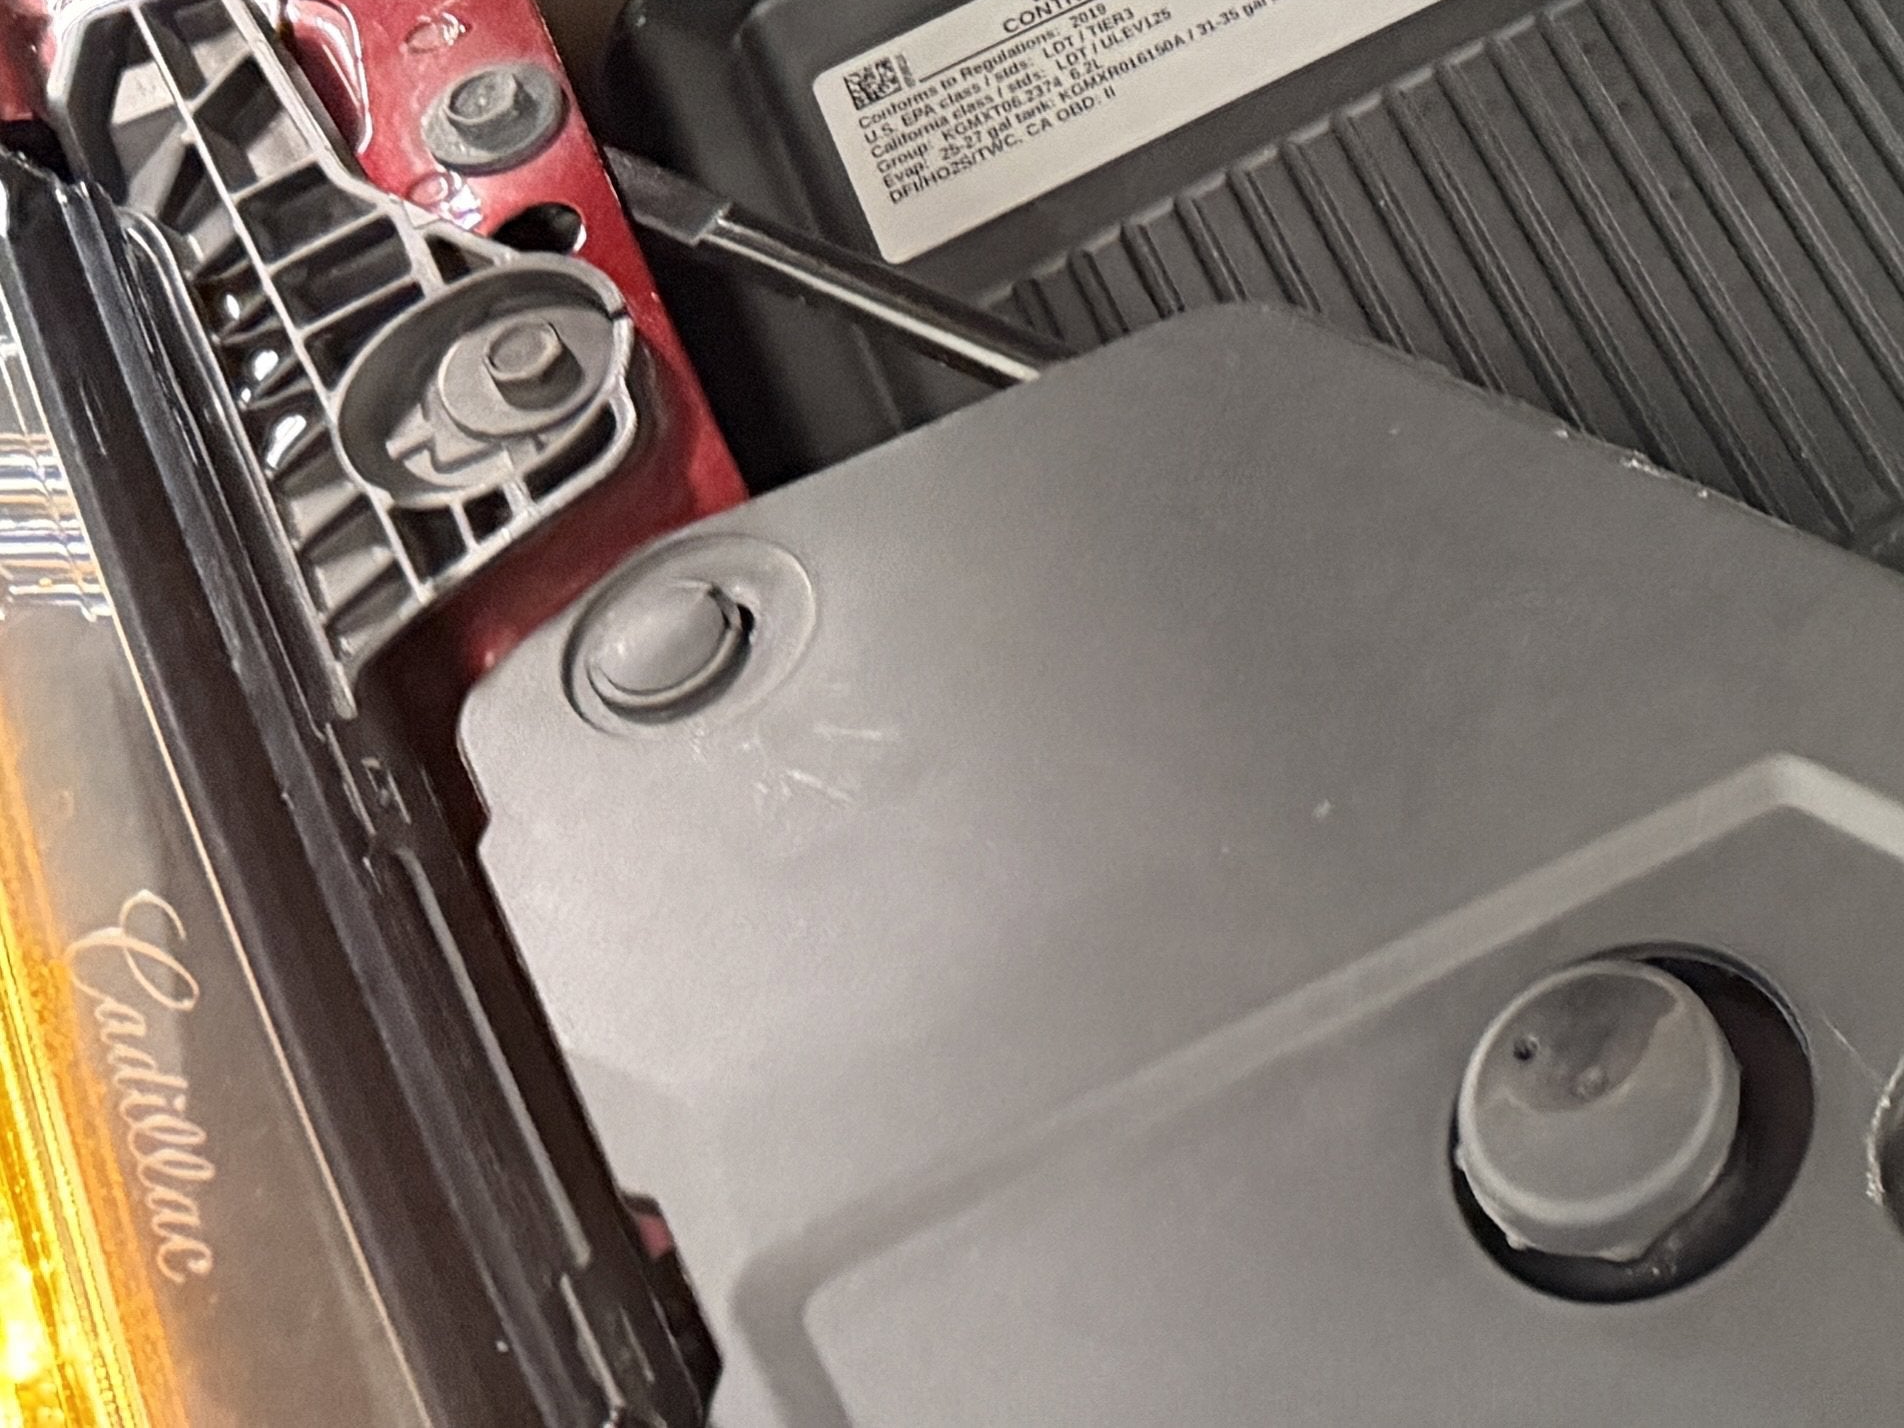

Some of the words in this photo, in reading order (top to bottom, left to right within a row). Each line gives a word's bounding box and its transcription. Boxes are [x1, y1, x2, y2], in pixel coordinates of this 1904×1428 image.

[858, 85, 938, 130] Conforms
[939, 76, 958, 91] to
[959, 27, 1060, 82] Regulations:
[863, 122, 896, 145] U.S.
[900, 103, 937, 127] EPA
[938, 83, 981, 110] class
[1041, 34, 1074, 59] LDT
[1085, 7, 1135, 37] TIER3
[870, 115, 950, 159] California
[951, 94, 994, 121] class
[1054, 45, 1087, 72] LDT
[1099, 6, 1172, 50] ULEV125
[938, 130, 982, 161] 25-27
[986, 115, 1012, 140] gal
[1195, 8, 1240, 36] 31-35
[1025, 117, 1053, 137] CA
[1103, 84, 1116, 99] II
[64, 888, 216, 1284] Cadillac
